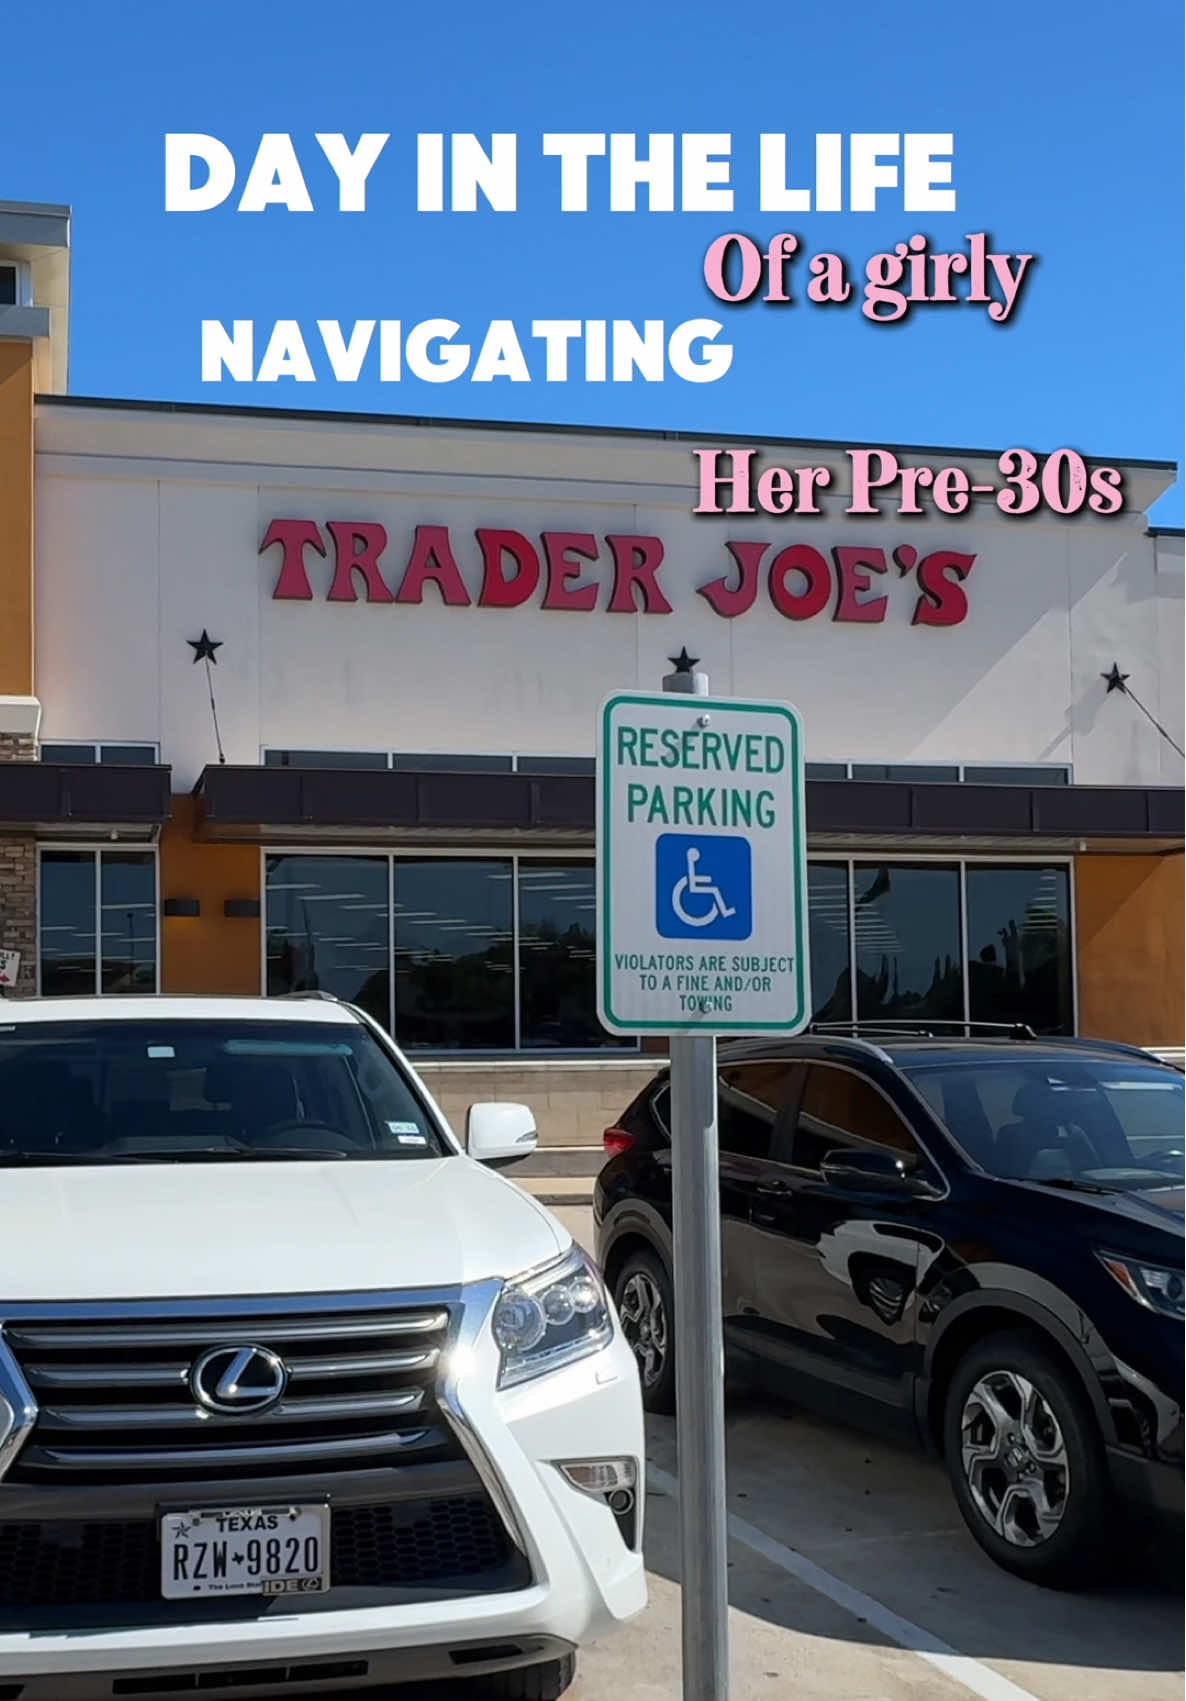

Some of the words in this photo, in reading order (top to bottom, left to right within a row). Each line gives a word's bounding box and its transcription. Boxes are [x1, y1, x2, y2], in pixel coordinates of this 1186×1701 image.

[259, 519, 673, 615] TRADER
[697, 540, 977, 627] JOE'S
[617, 726, 784, 774] RESERVED
[627, 783, 776, 829] PARKING
[615, 954, 694, 972] VIOLATORS
[698, 955, 727, 972] ARE
[731, 956, 795, 974] SUBJECT
[640, 974, 657, 991] TO
[661, 974, 672, 991] A
[676, 975, 709, 992] FINE
[714, 975, 772, 992] AND/OR
[216, 1515, 278, 1533] TEXAS
[173, 1540, 228, 1581] RZW
[246, 1536, 319, 1576] 9820
